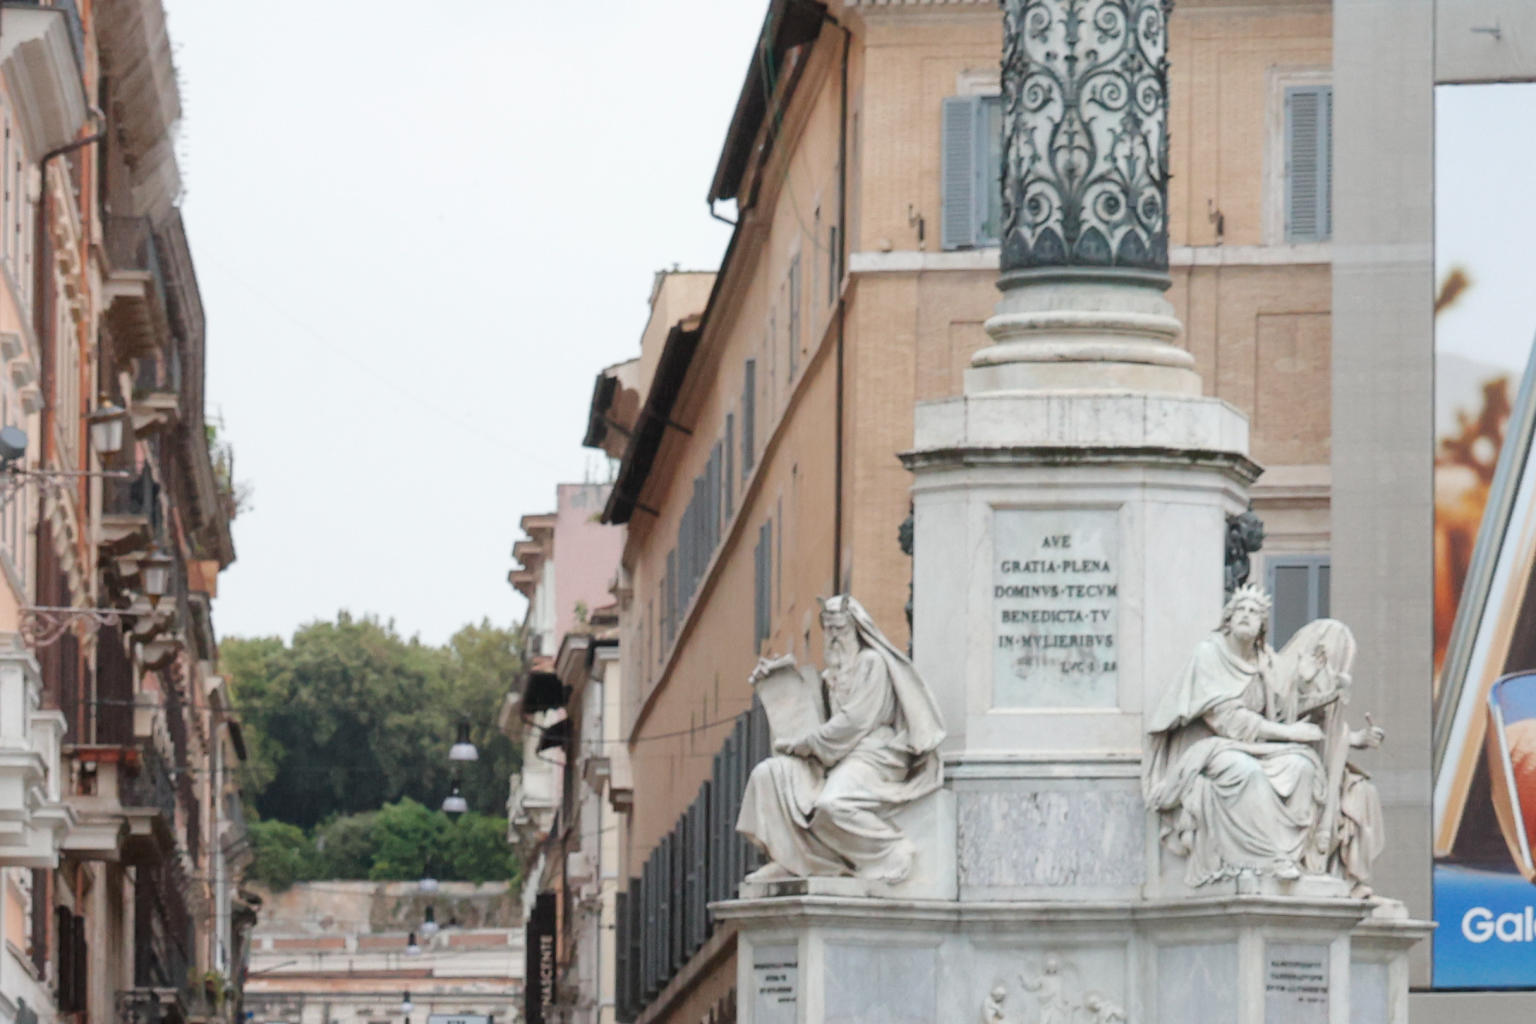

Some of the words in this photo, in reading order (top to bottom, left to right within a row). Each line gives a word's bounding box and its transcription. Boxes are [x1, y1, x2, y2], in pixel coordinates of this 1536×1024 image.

[1041, 534, 1072, 549] AVE
[1000, 560, 1056, 574] GRATIA
[1062, 560, 1111, 573] PLENA
[1001, 610, 1084, 623] BENEDICTA
